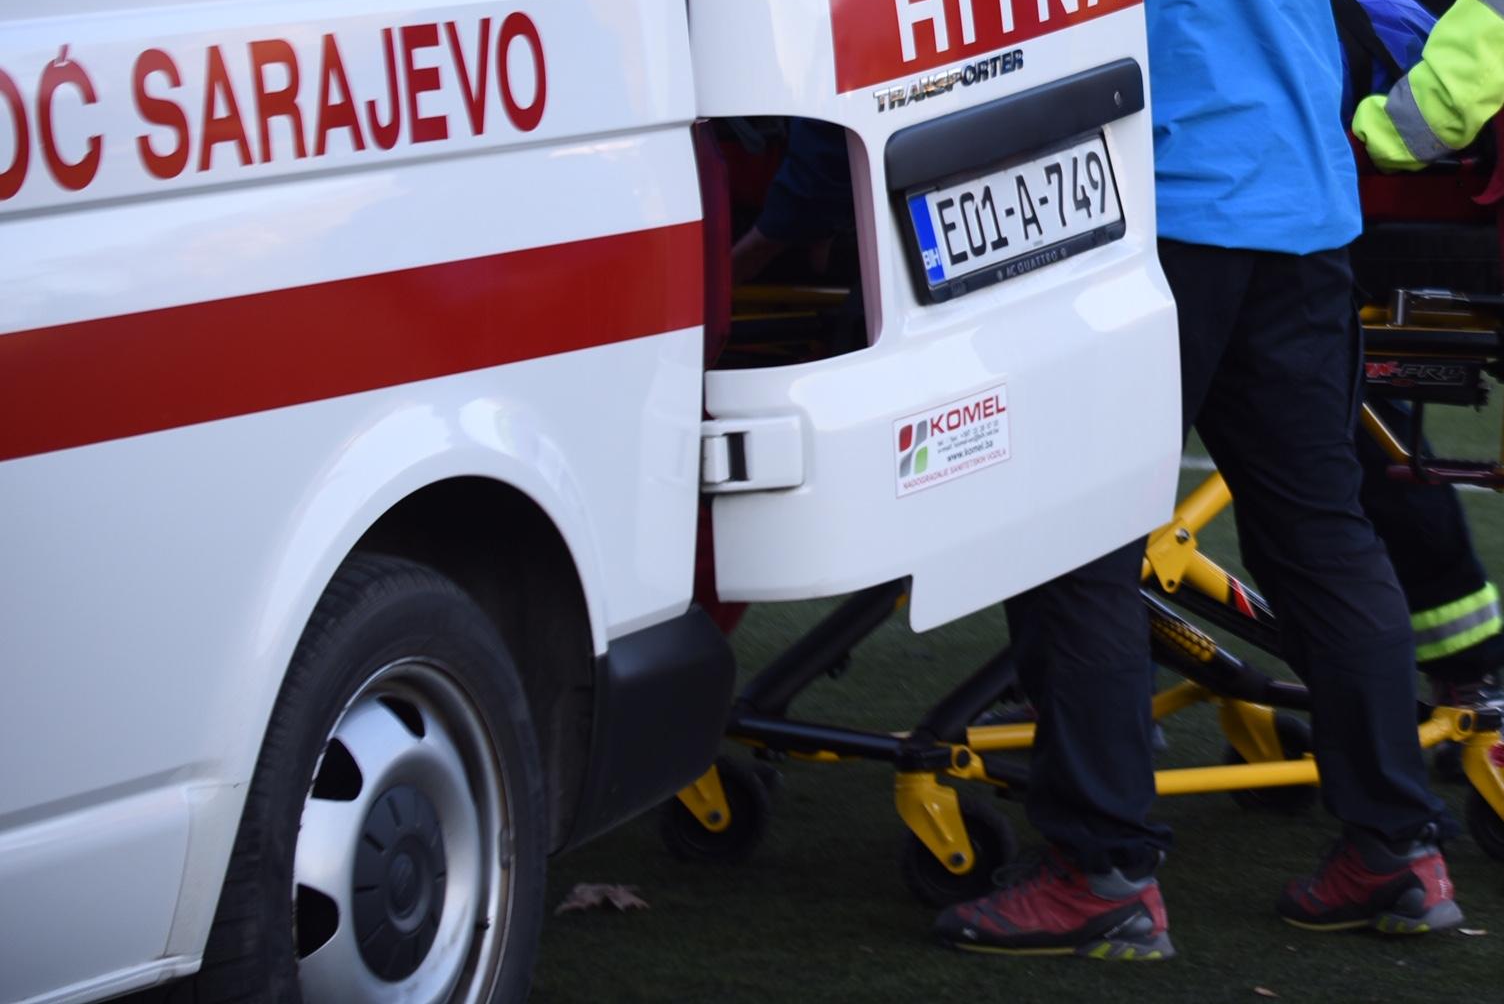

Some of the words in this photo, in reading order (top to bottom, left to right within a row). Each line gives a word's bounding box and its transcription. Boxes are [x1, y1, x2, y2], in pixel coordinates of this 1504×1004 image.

[131, 10, 548, 181] SARAJEVO
[872, 48, 1024, 113] TRANSPORTER
[922, 247, 941, 270] BH
[936, 150, 1107, 267] E01-A-749
[930, 394, 1006, 438] KOMEL
